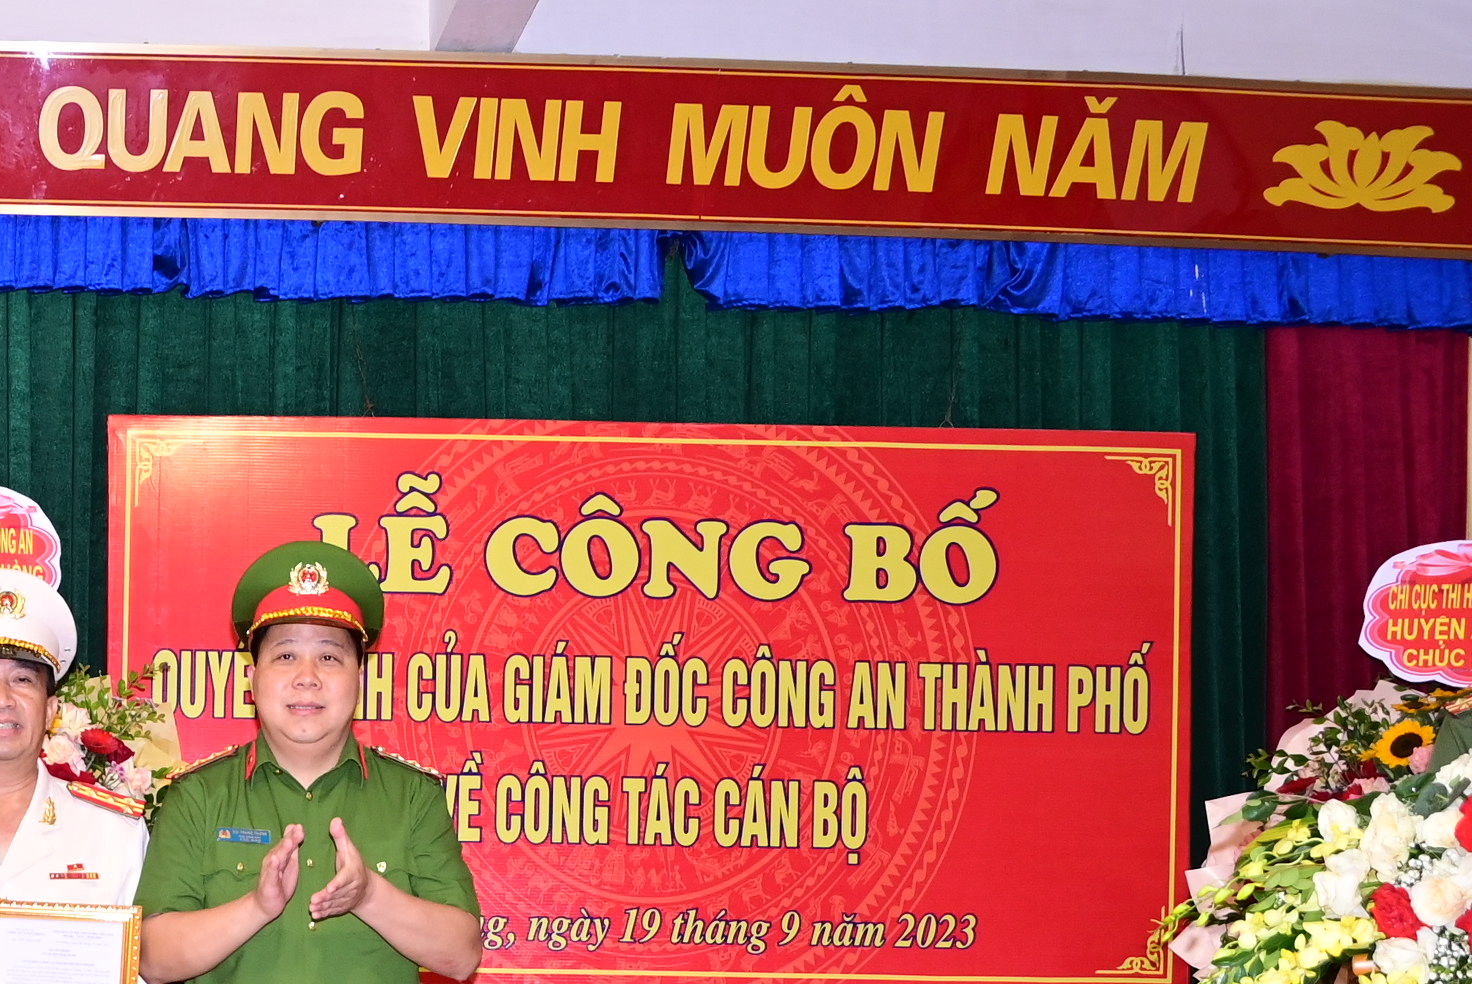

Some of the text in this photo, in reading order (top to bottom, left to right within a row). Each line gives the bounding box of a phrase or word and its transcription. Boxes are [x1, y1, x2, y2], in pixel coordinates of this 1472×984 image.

[39, 86, 365, 176] QUANG
[414, 95, 623, 183] VINH
[667, 84, 946, 193] MUÔN
[987, 96, 1209, 203] NĂM
[17, 528, 33, 555] AN
[485, 492, 812, 603] CÔNG
[842, 487, 1000, 606] BỐ
[1388, 584, 1410, 610] CHI
[1411, 583, 1439, 616] CỤC
[1441, 583, 1462, 609] THI
[1387, 615, 1466, 646] HUYỆN
[1403, 643, 1466, 667] CHÚC
[406, 629, 492, 724] CỦA
[503, 639, 614, 726] GIÁM
[623, 631, 710, 729] ĐỐC
[721, 643, 837, 731] CÔNG
[846, 659, 908, 732] AN
[917, 647, 1056, 734] THÀNH
[1066, 640, 1153, 737] PHỐ
[495, 759, 611, 847] CÔNG
[621, 761, 702, 849] TÁC
[713, 763, 801, 850] CÁN
[811, 765, 869, 867] BỘ
[527, 907, 609, 951] ngày
[619, 906, 662, 944] 19
[670, 908, 772, 955] tháng
[779, 909, 802, 947] 9
[809, 913, 888, 949] năm
[893, 911, 979, 951] 2023
